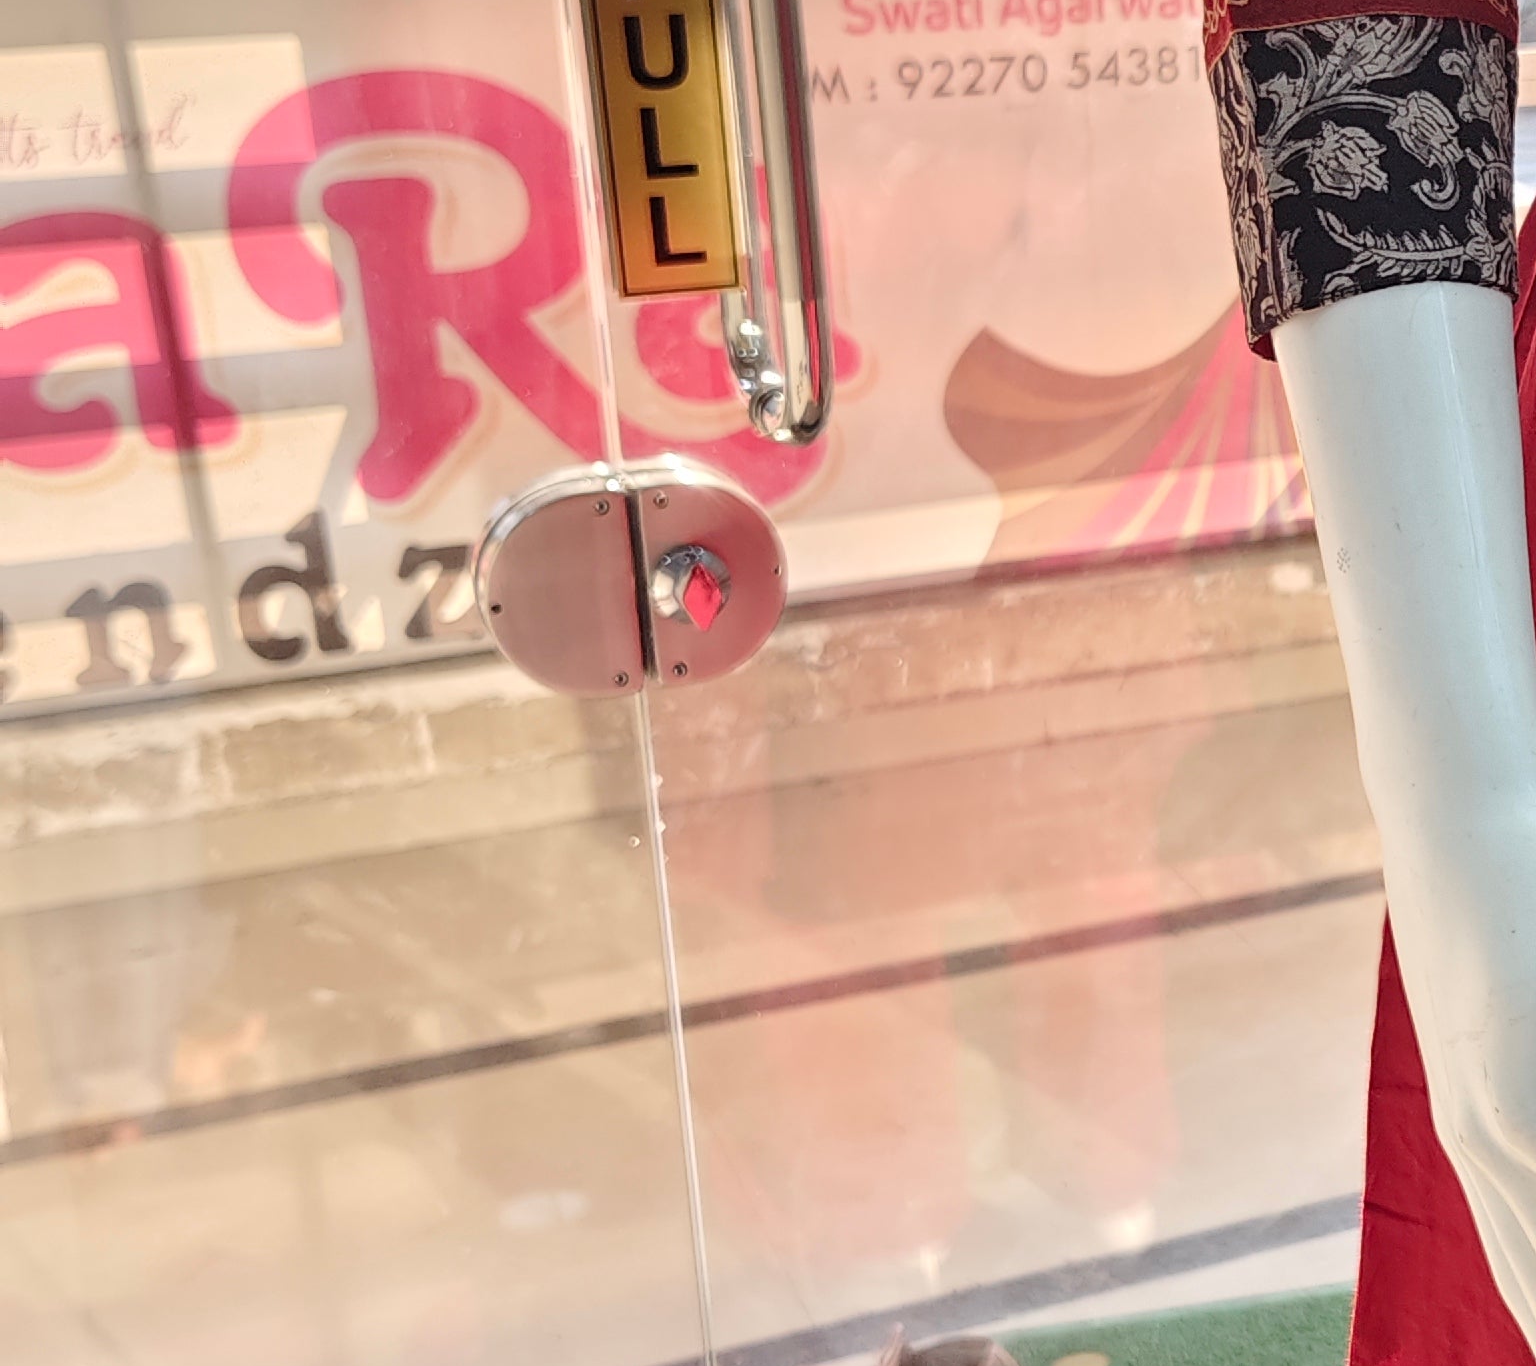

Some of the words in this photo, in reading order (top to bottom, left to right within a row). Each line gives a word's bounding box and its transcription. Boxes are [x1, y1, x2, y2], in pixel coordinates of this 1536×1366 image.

[896, 54, 1048, 100] 92270
[1065, 45, 1201, 91] 54381
[0, 510, 490, 705] ndz
